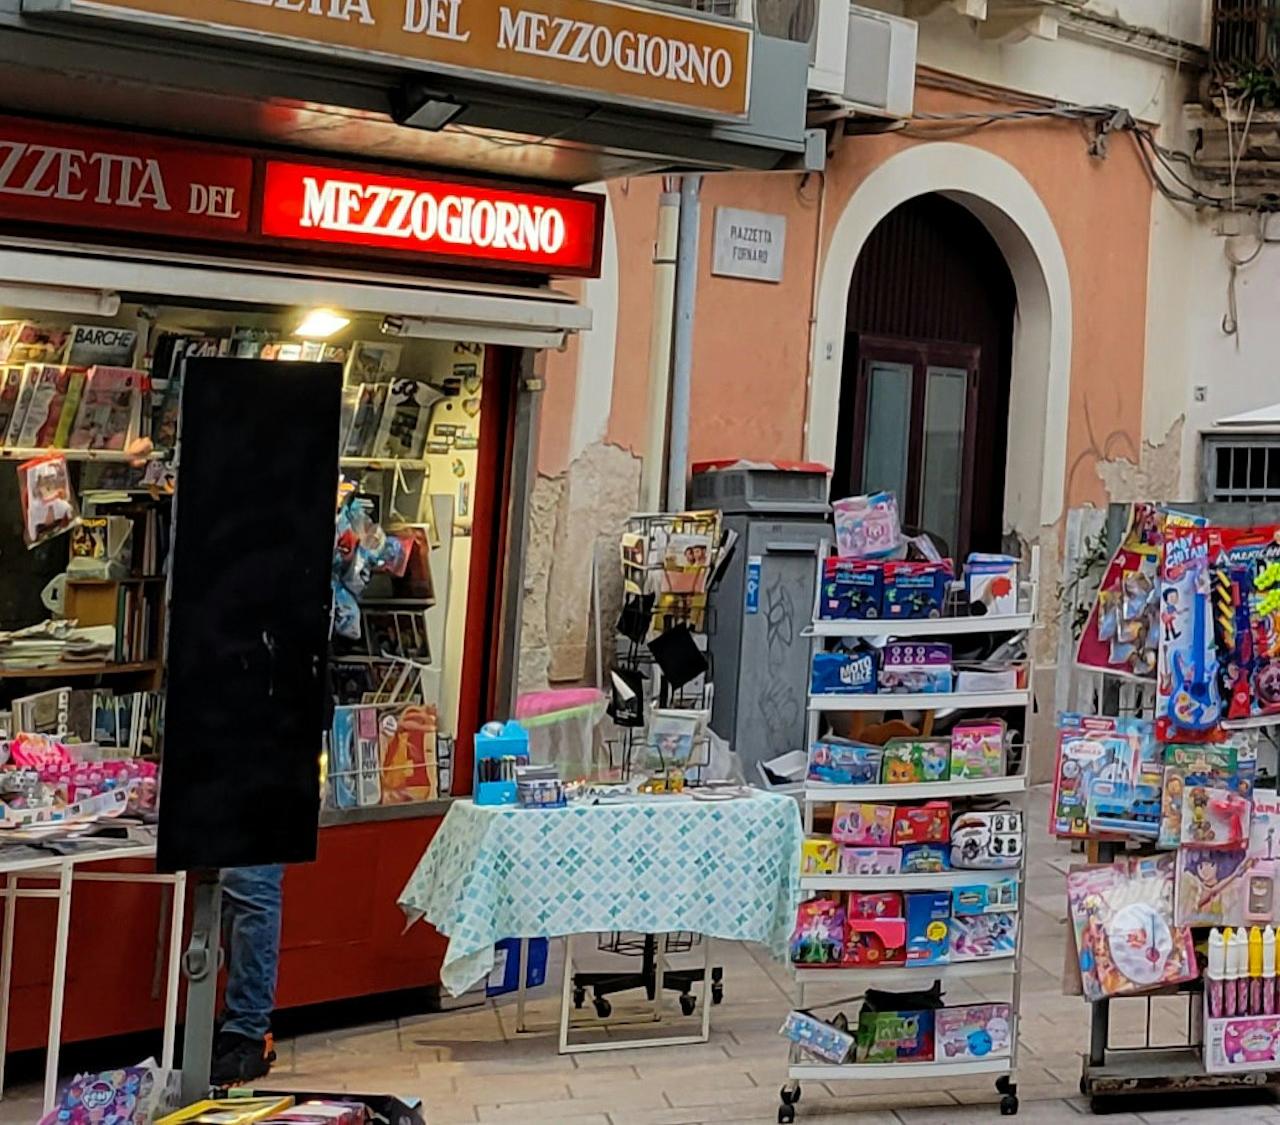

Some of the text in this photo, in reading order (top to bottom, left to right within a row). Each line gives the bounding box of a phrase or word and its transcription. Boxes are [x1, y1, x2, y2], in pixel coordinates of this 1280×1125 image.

[498, 7, 733, 90] MEZZOGIORNO
[188, 183, 241, 219] DEL
[301, 176, 565, 255] MEZZOGIORNO
[730, 225, 772, 243] PIAZZETTA
[74, 328, 133, 347] BARCHE
